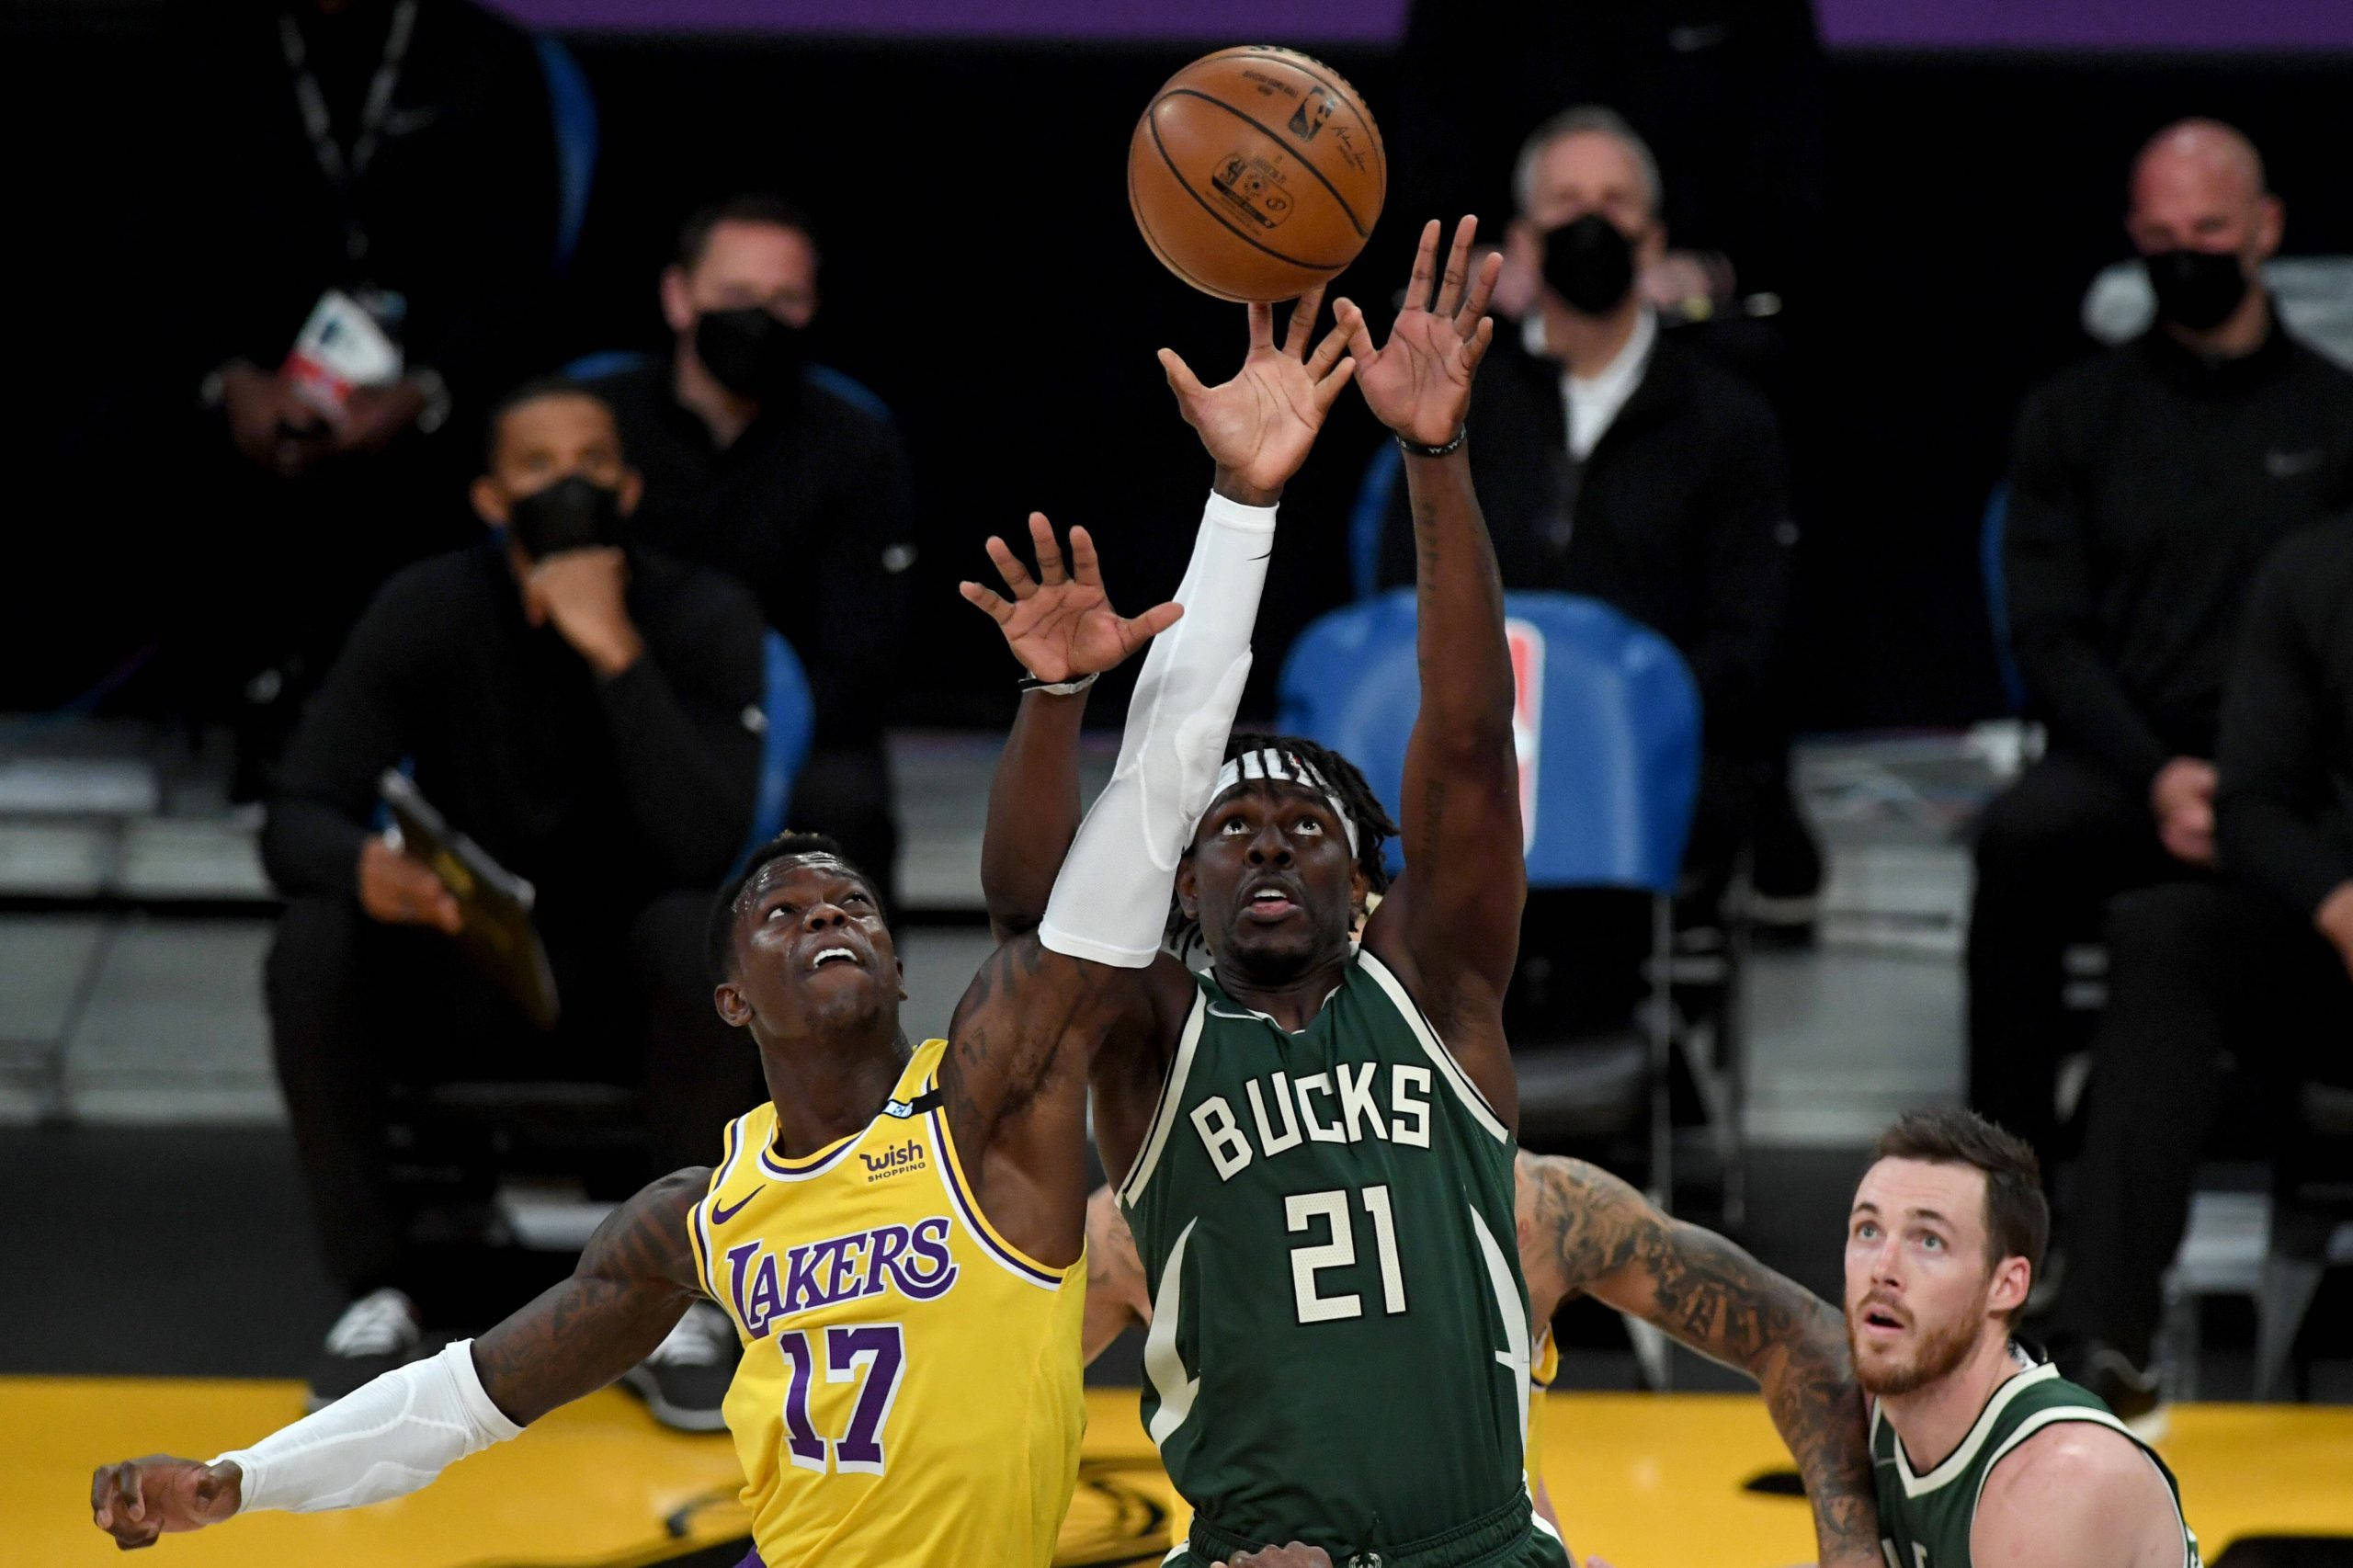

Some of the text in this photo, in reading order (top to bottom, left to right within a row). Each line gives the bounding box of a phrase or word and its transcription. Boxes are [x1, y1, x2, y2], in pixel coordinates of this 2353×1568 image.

[858, 1140, 924, 1172] wish
[868, 1162, 926, 1183] SHOPPING
[1189, 1061, 1432, 1183] BUCKS
[725, 1216, 961, 1341] LAKERS
[1284, 1184, 1407, 1324] 21
[778, 1322, 907, 1477] 17
